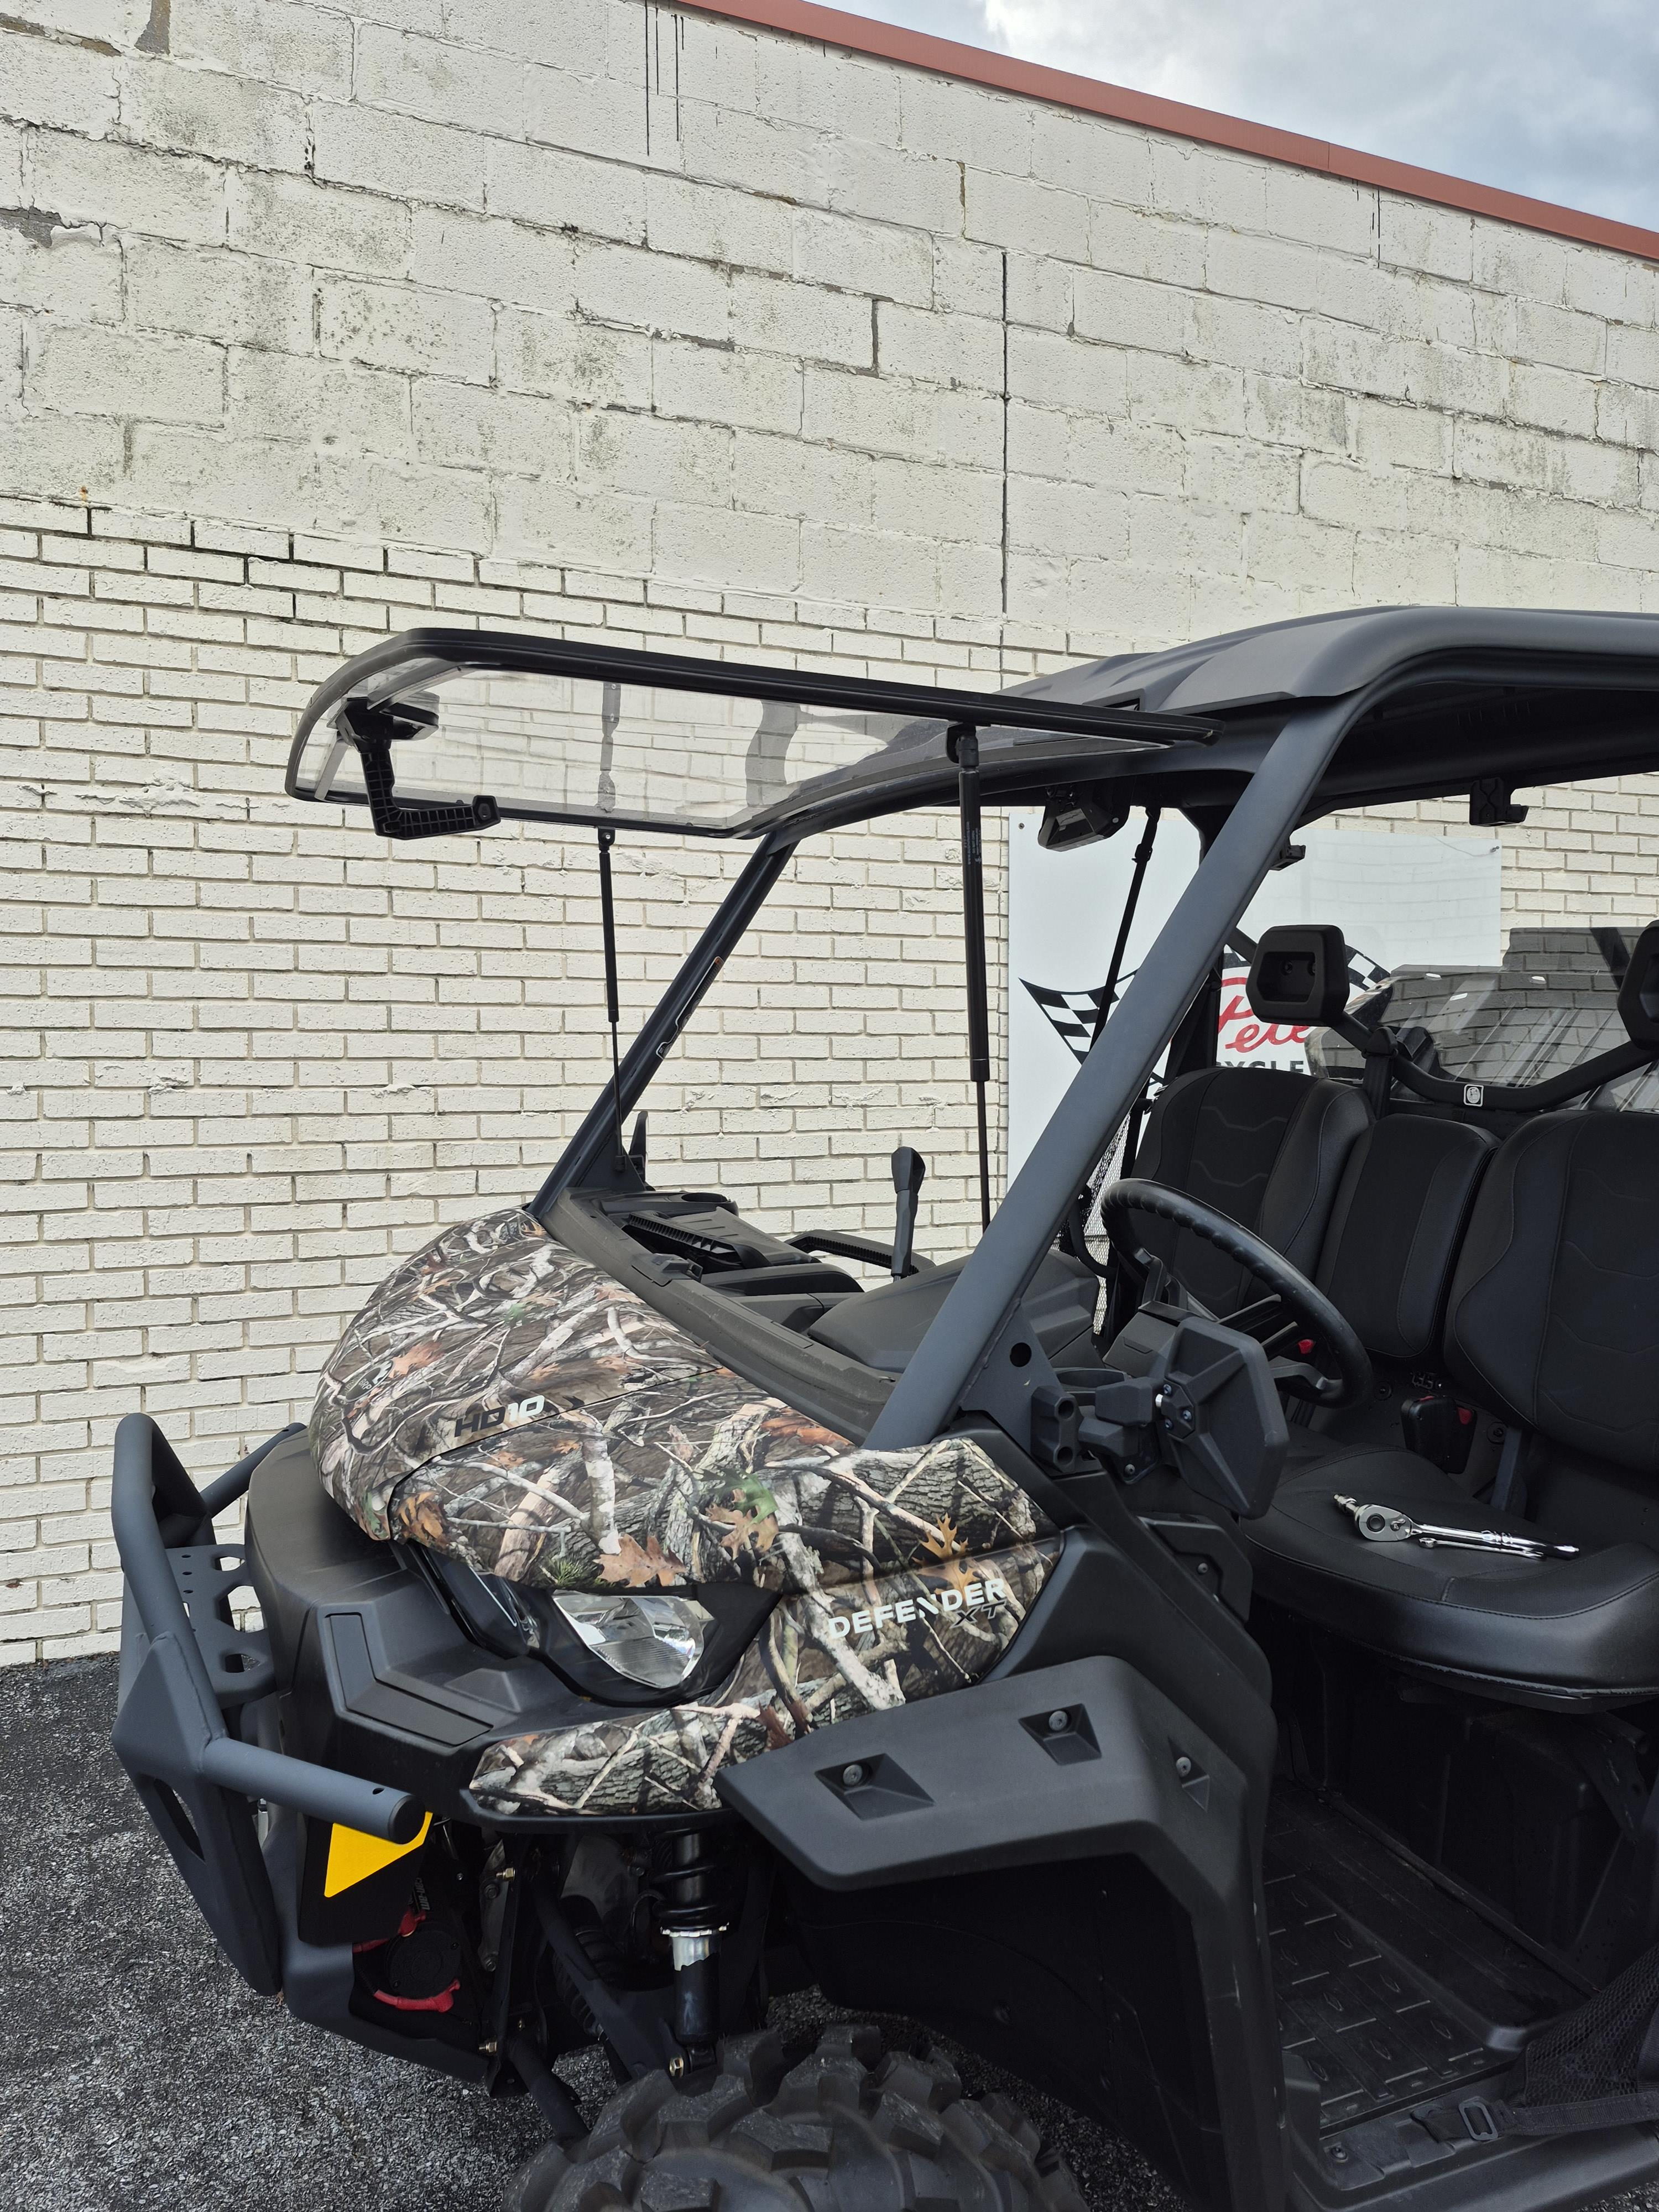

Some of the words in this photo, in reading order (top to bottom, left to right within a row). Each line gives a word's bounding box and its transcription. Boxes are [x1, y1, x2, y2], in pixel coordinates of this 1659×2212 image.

[359, 1379, 372, 1390] BRP
[455, 1395, 545, 1437] HD10
[830, 1578, 1008, 1639] DEFENDER
[950, 1599, 1007, 1629] XT
